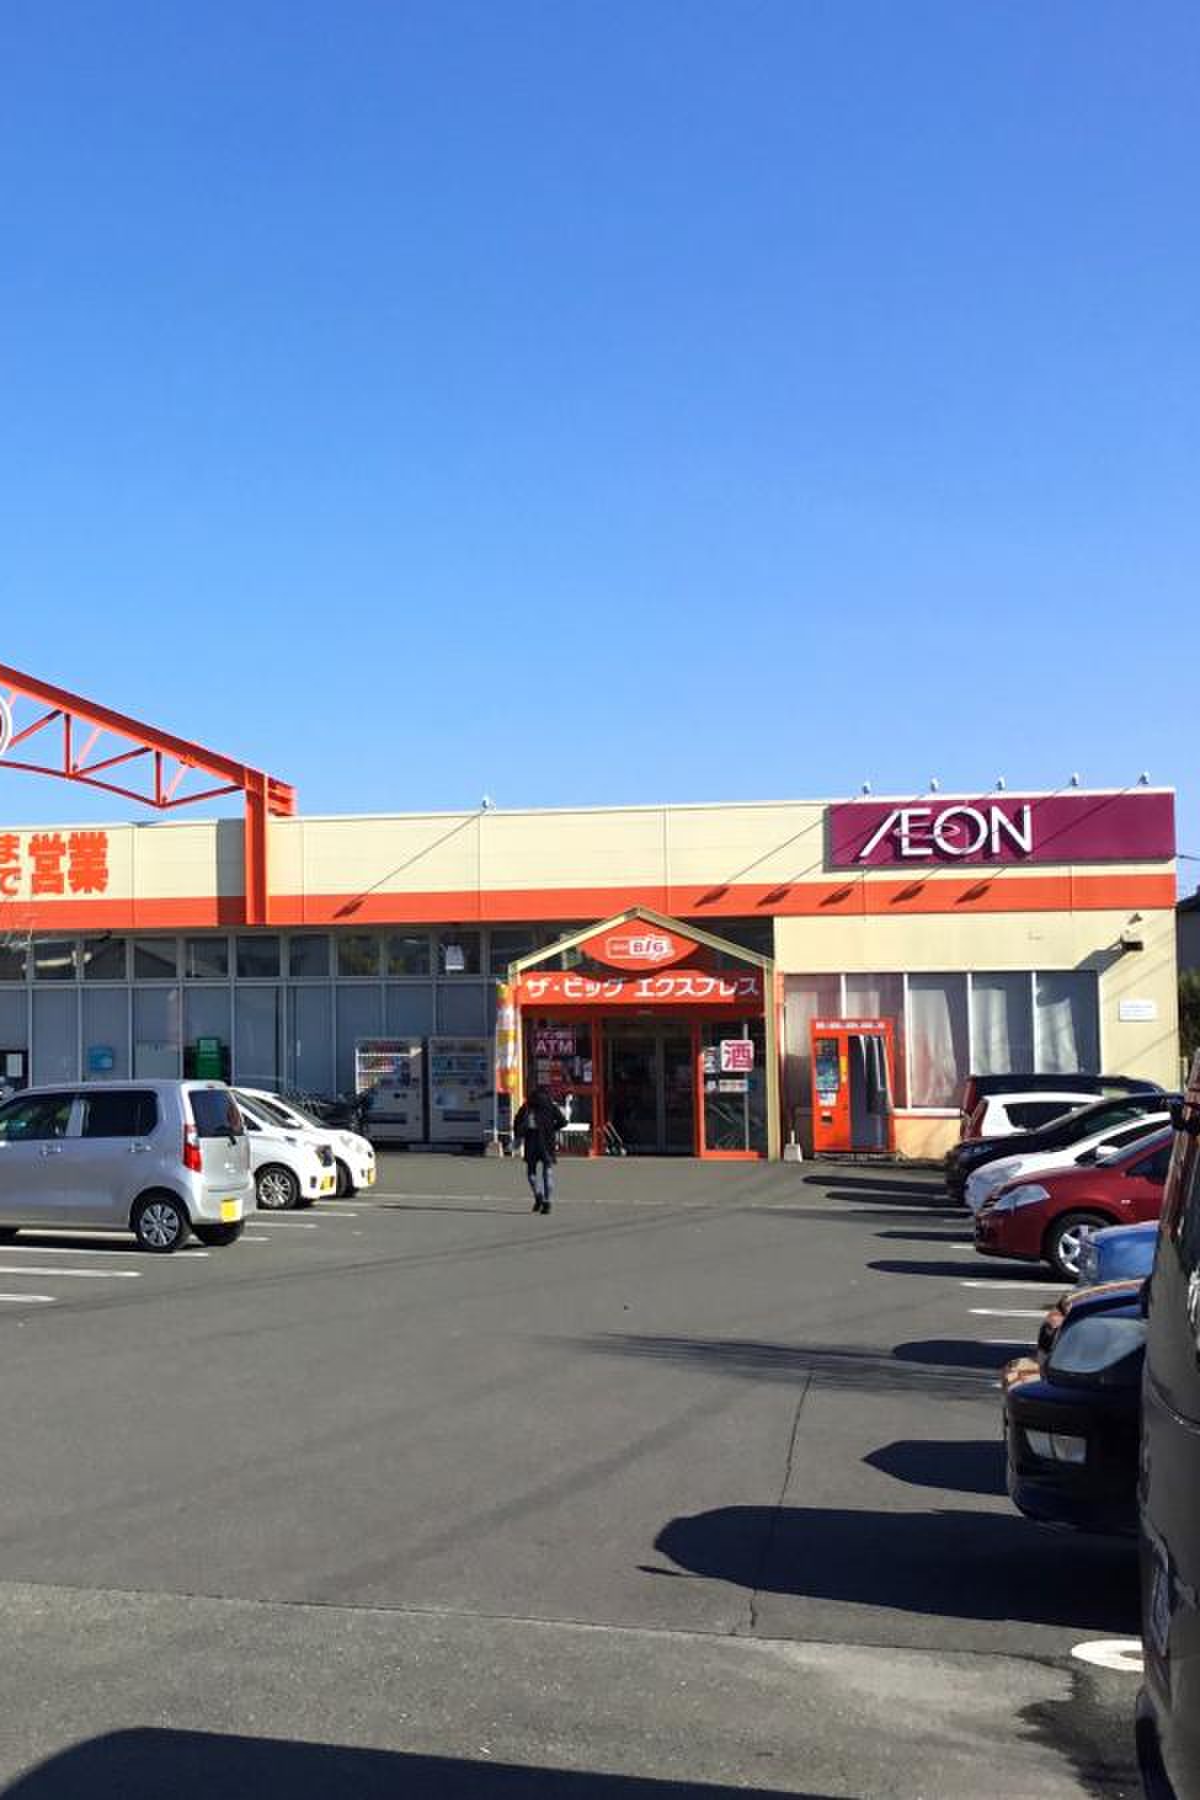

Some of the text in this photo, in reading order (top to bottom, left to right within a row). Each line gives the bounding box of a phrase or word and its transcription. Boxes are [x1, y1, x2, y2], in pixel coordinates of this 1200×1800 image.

[633, 976, 759, 998] エクスプレス
[535, 1039, 574, 1055] ATM
[723, 1042, 752, 1069] 酒
